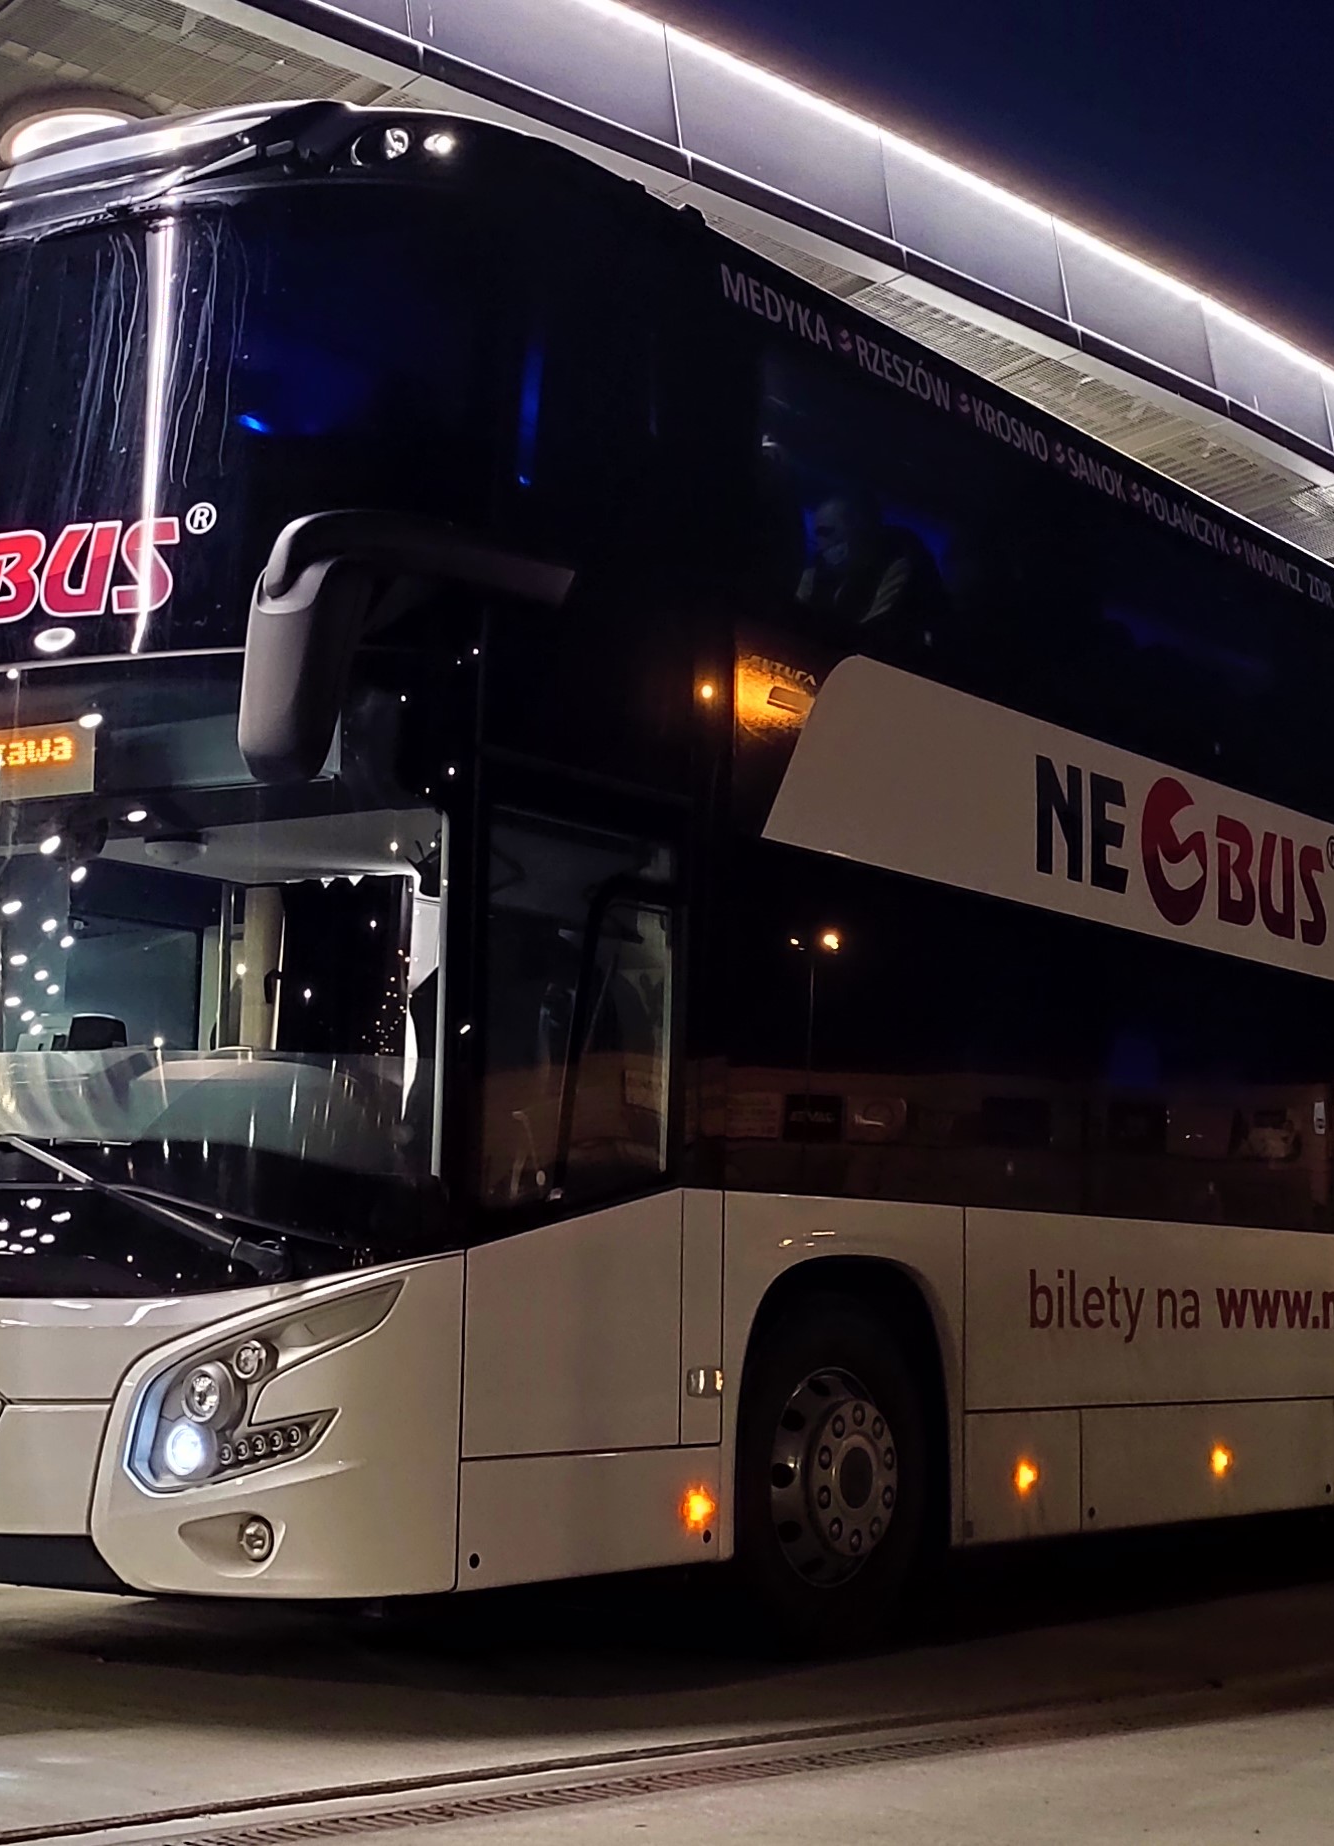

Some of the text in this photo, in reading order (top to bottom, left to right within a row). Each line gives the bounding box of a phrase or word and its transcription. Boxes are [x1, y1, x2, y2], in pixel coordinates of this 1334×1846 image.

[720, 263, 833, 352] MEDYKA
[855, 335, 951, 413] RZESZÓW
[970, 395, 1049, 463] KROSNO
[1067, 446, 1127, 503] SANOK
[1142, 485, 1231, 556] POLAŃCZYK
[1243, 539, 1304, 593] IWONICZ
[1028, 1269, 1145, 1344] bilety
[1156, 1286, 1201, 1330] na
